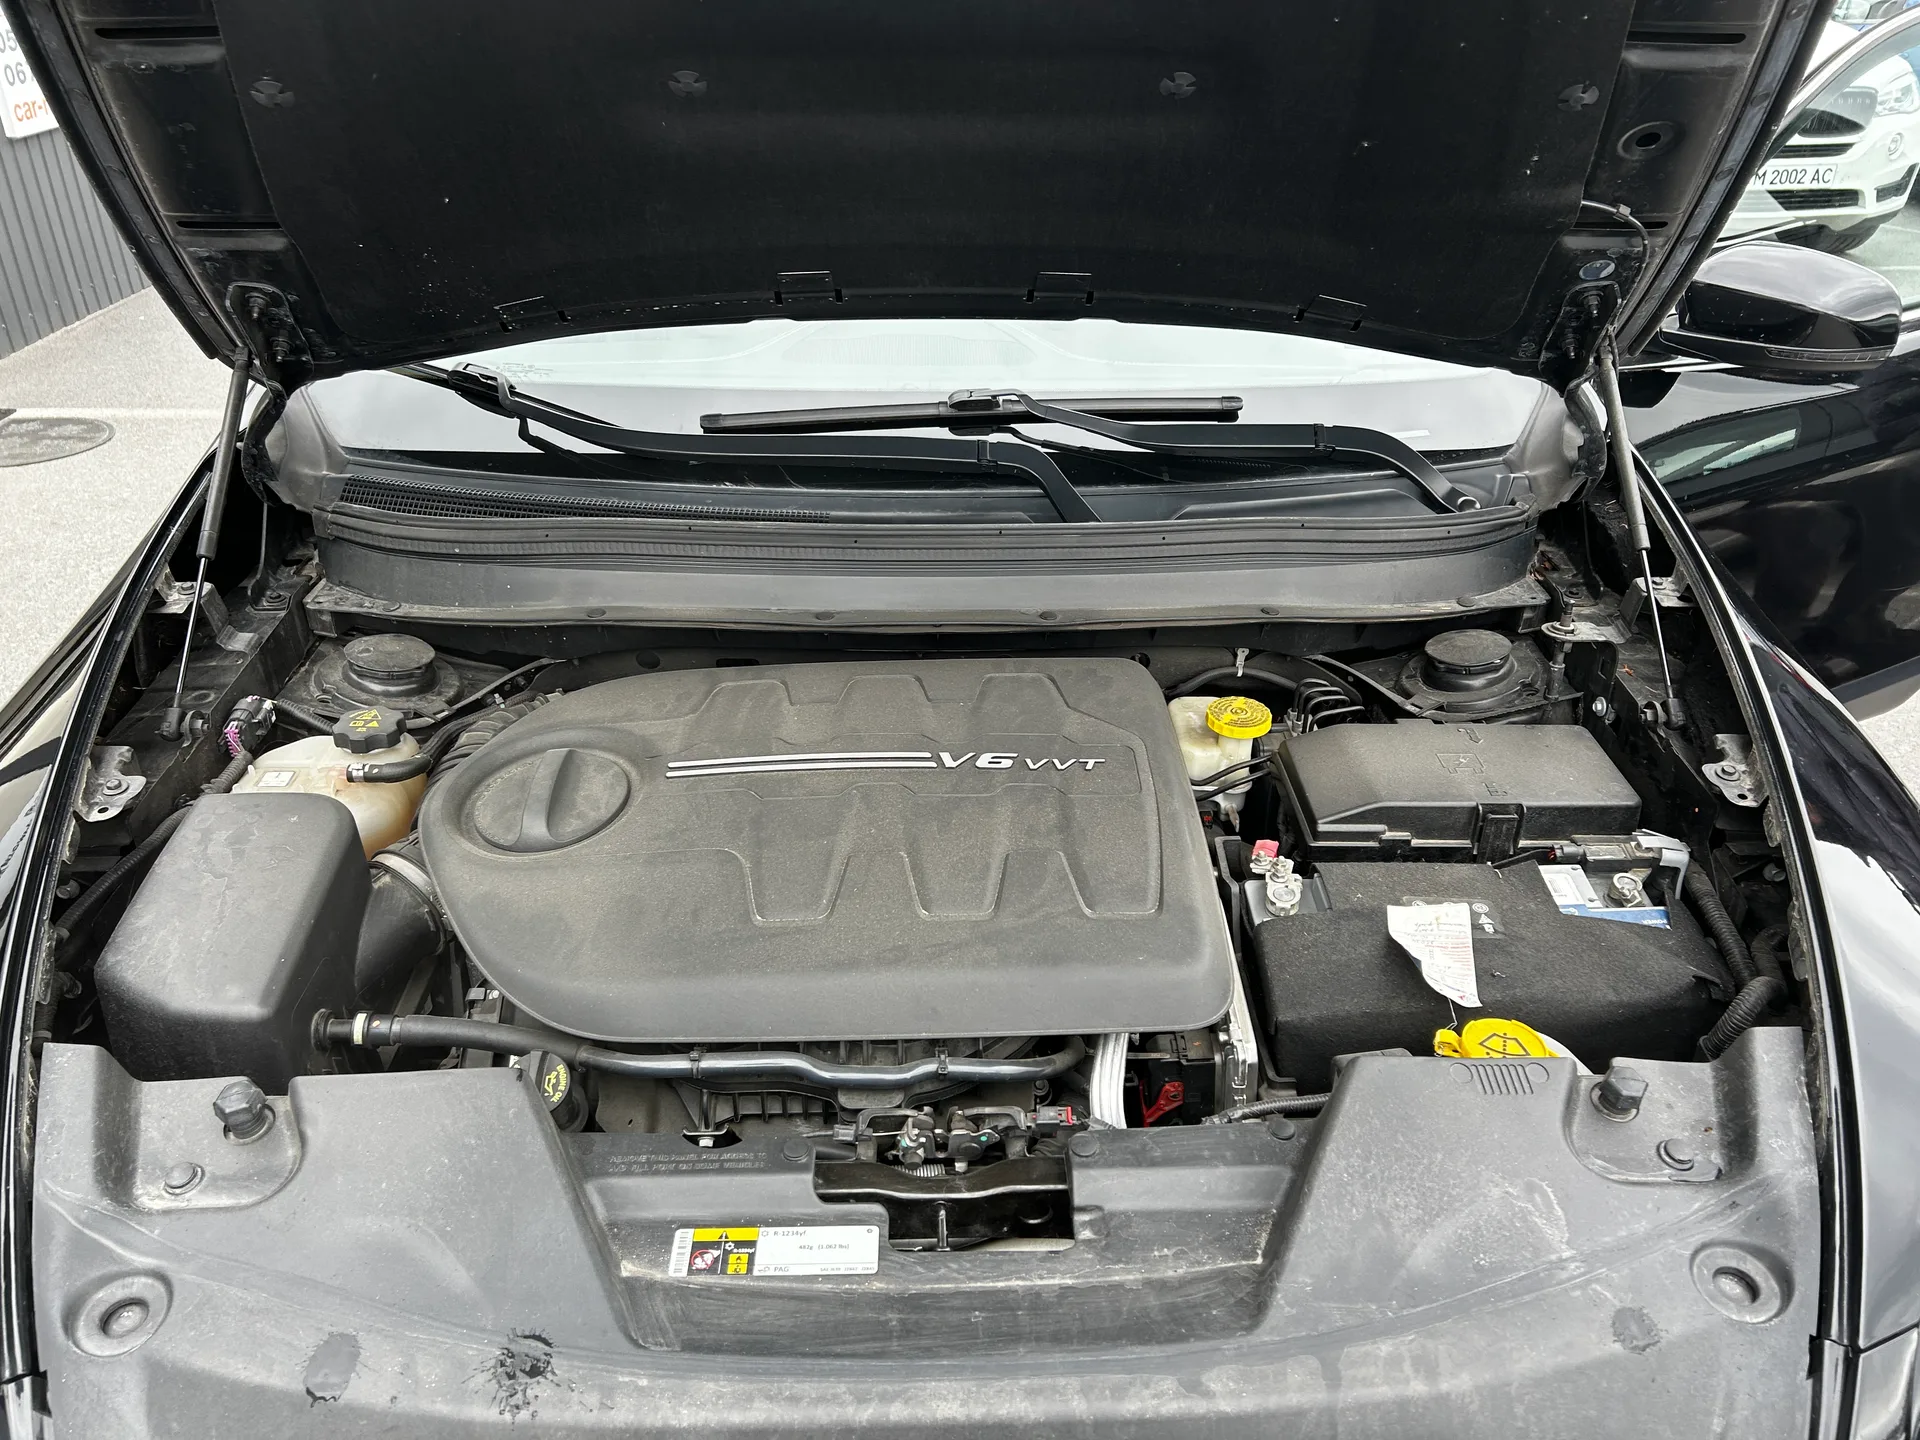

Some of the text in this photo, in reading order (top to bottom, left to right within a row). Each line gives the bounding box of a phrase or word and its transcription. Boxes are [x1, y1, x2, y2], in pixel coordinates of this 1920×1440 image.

[1769, 169, 1807, 185] 2002
[1810, 168, 1833, 184] AC
[938, 752, 1106, 770] V6 VVT
[550, 1064, 567, 1102] ENGINE OIL
